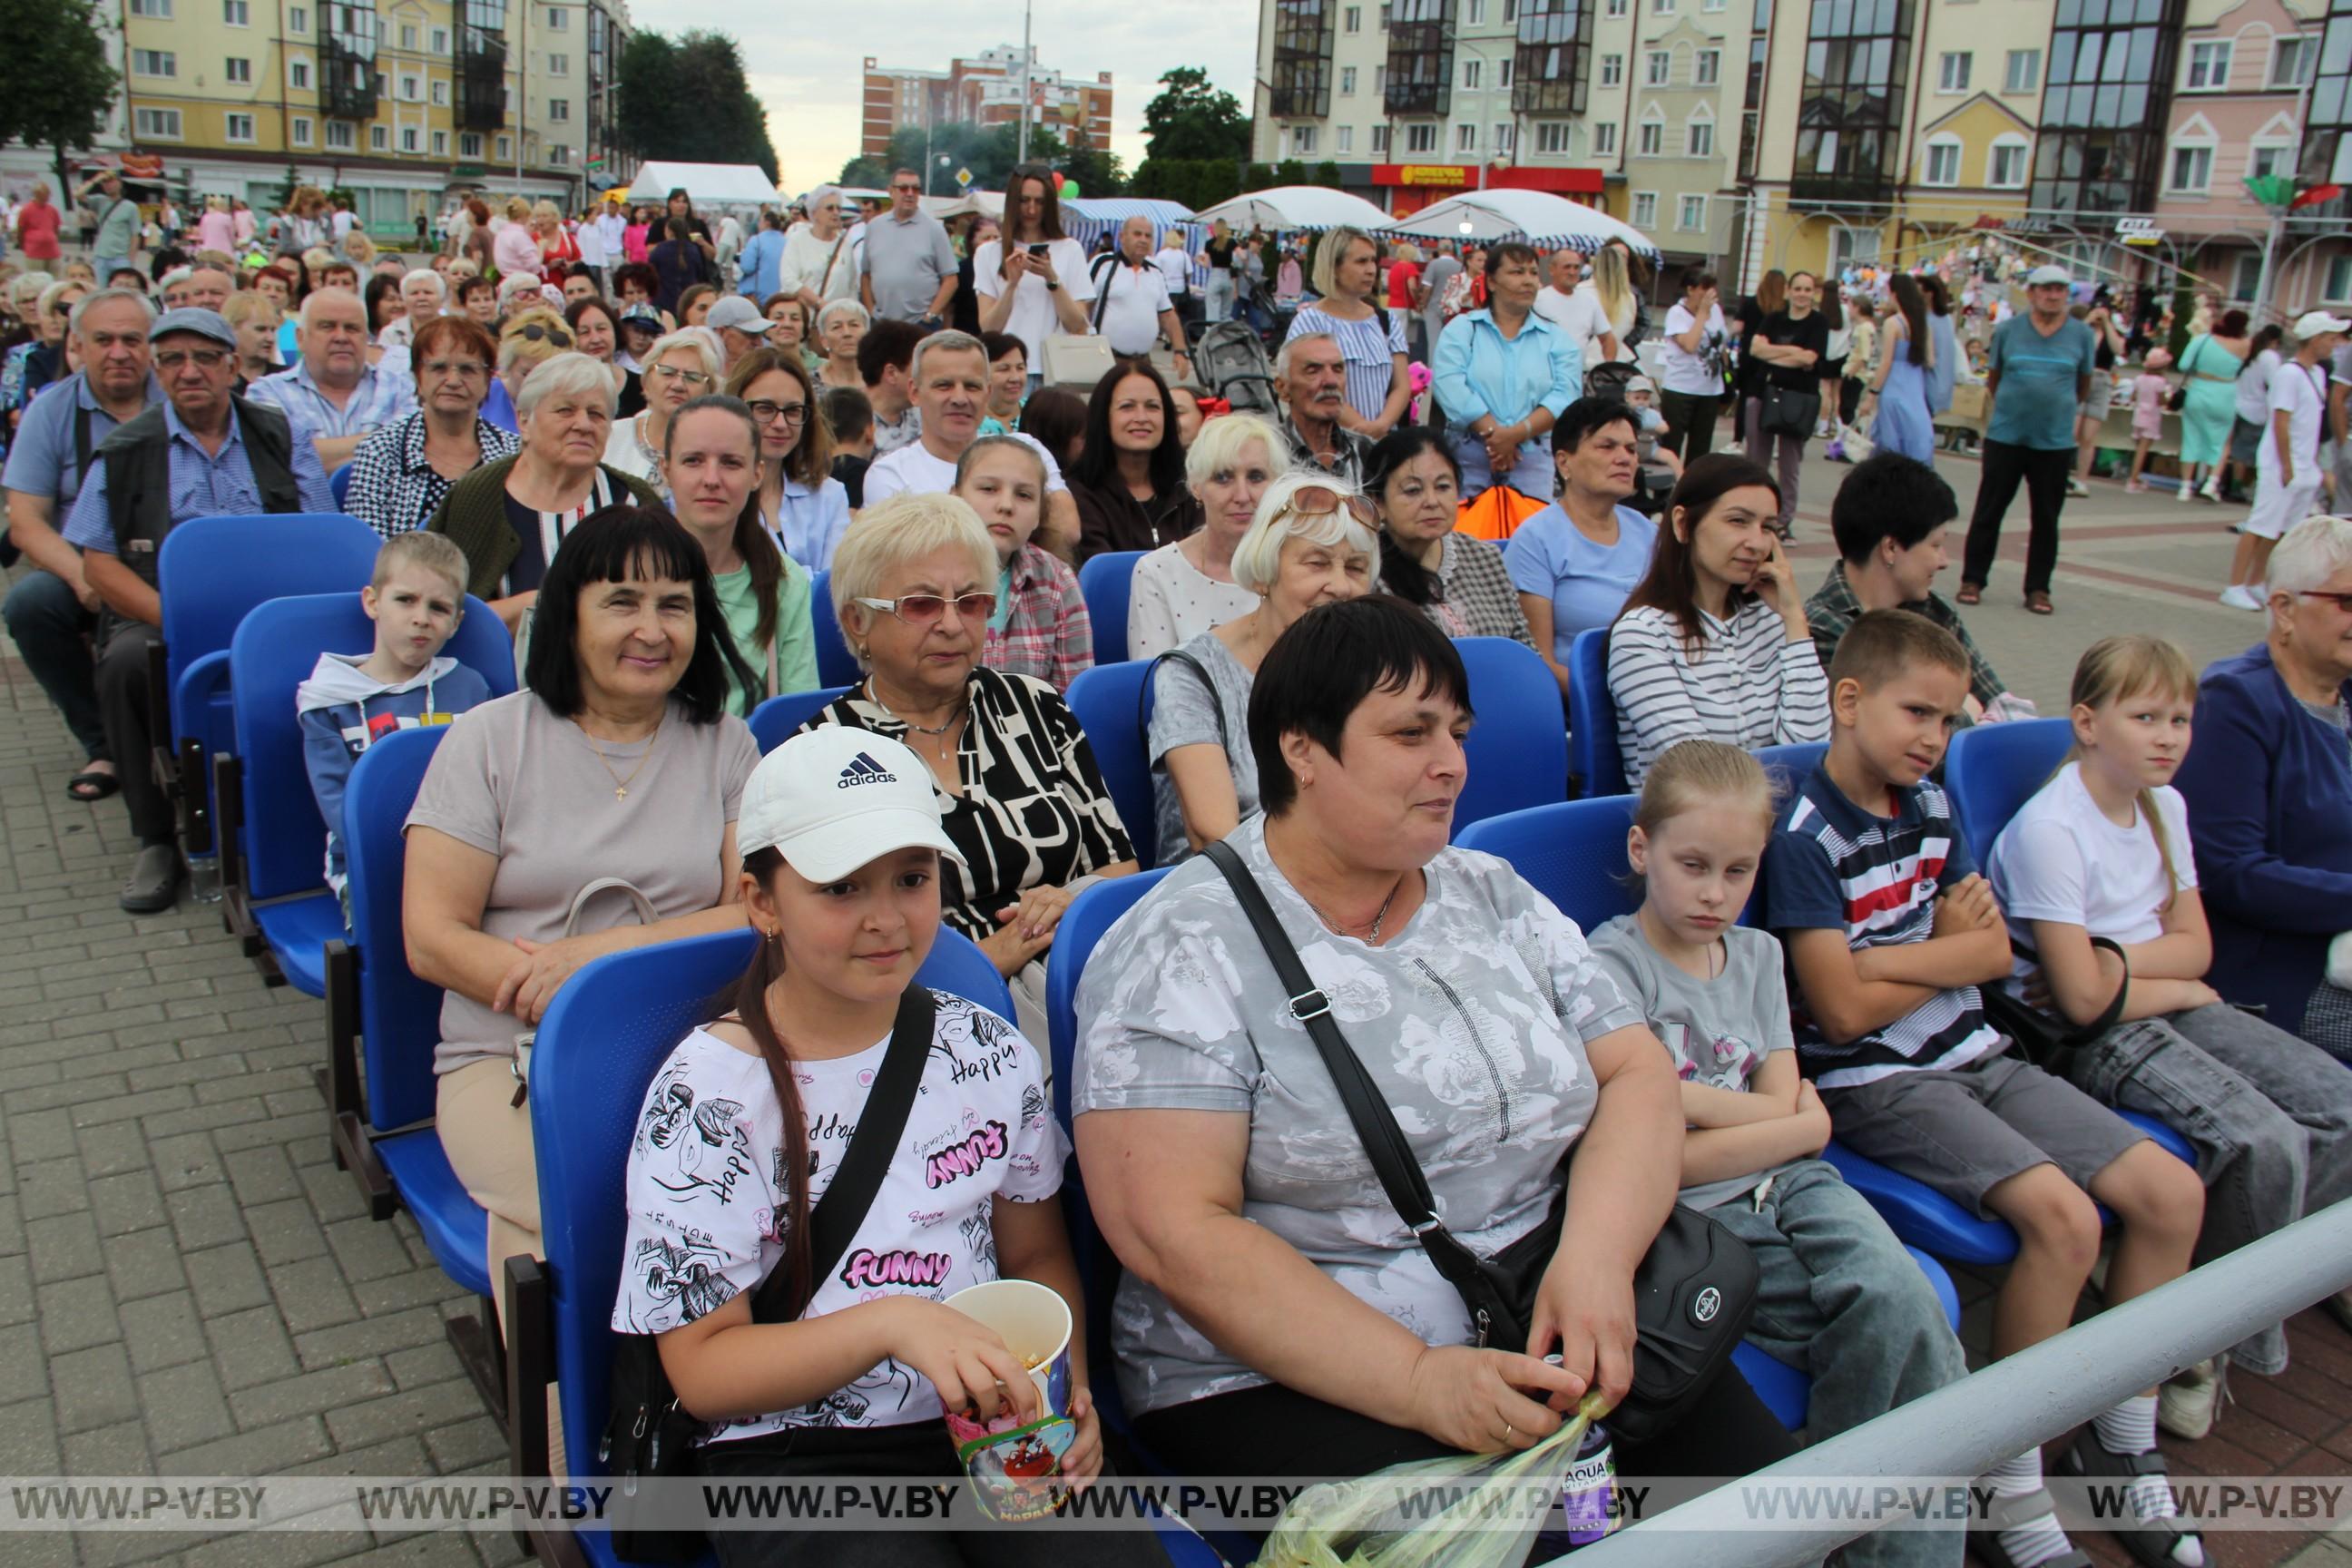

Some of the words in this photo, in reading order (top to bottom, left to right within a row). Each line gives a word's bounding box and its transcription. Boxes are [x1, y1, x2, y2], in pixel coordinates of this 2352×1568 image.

[838, 771, 897, 789] adidas
[951, 1045, 1018, 1085] Happy
[711, 1126, 750, 1205] Happy
[1564, 1462, 1604, 1484] AQUA
